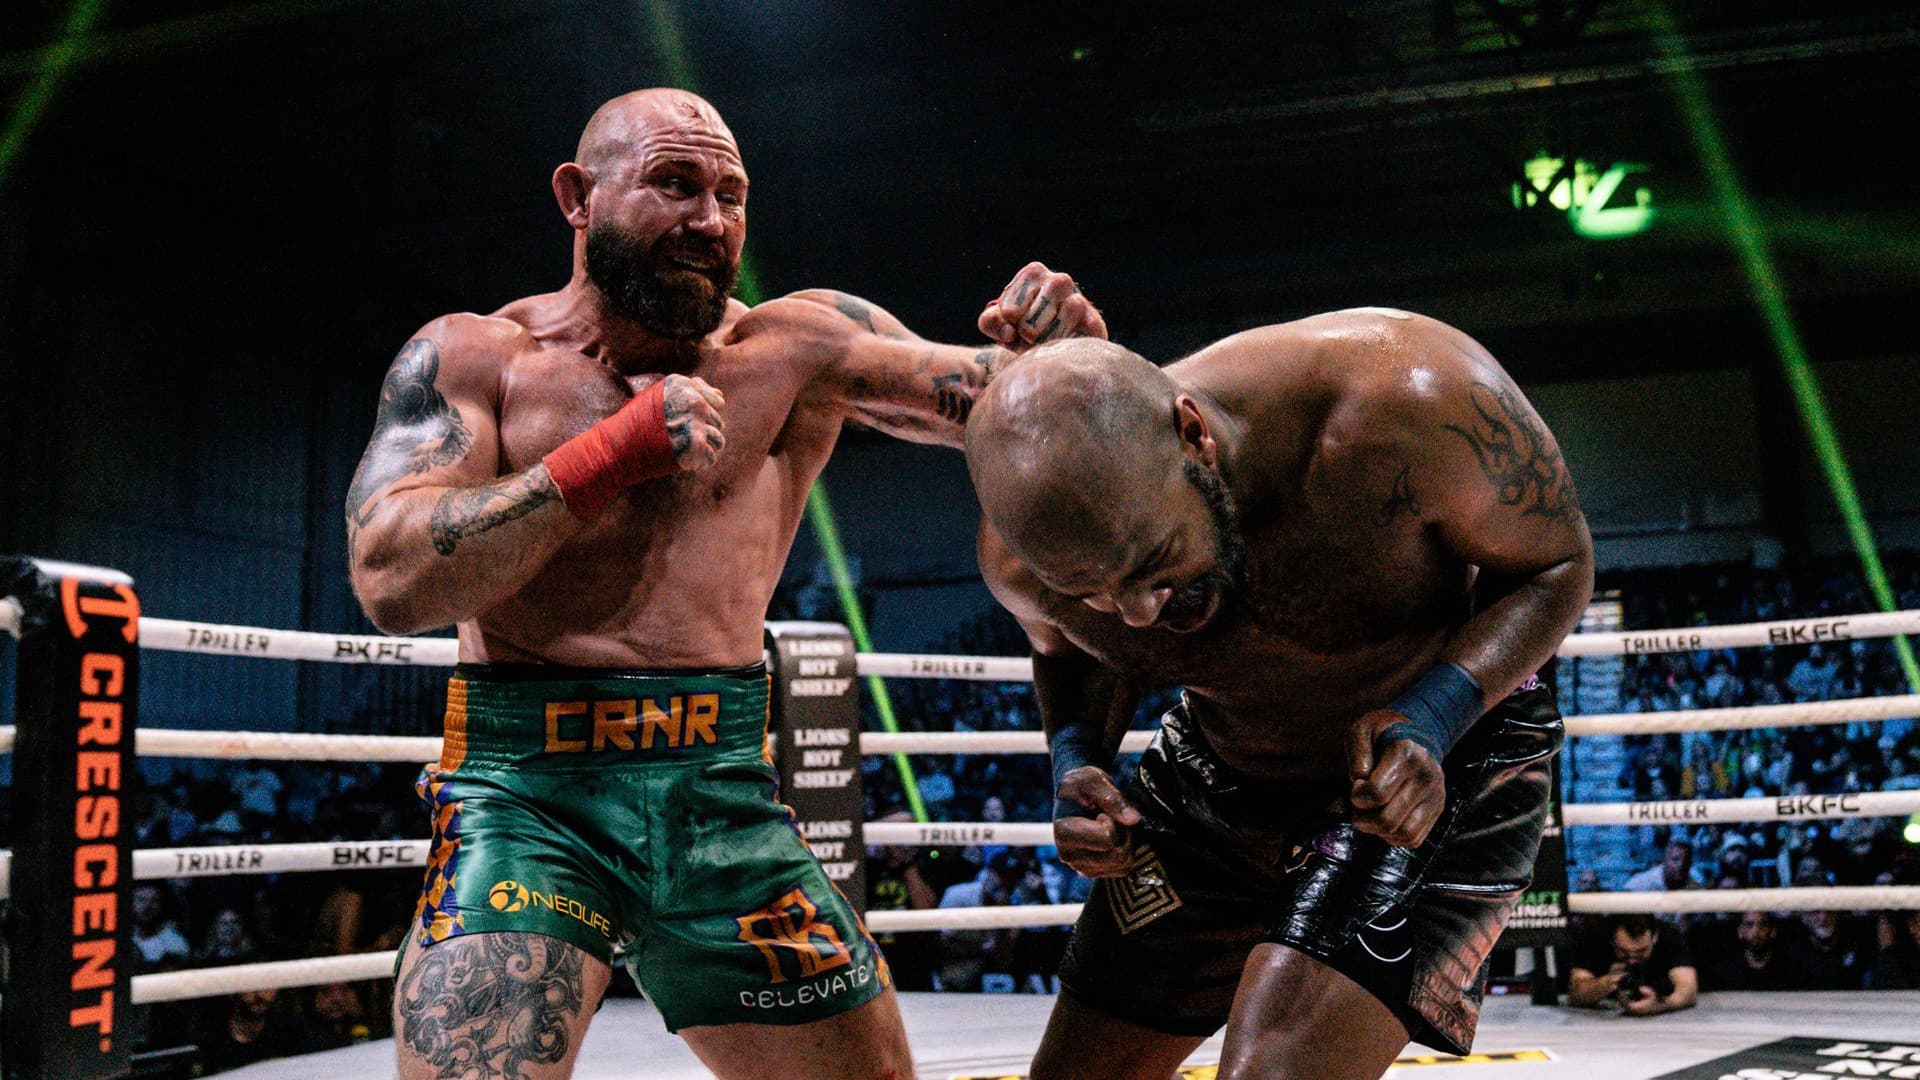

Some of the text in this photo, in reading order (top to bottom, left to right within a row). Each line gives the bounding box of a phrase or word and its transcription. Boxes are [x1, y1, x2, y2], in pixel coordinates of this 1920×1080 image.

[186, 628, 413, 662] TRILLER BKFC
[1622, 621, 1852, 651] TRILLER BKFC
[799, 659, 838, 676] NOT
[912, 659, 986, 675] TRILLER
[543, 693, 720, 754] CRNR
[794, 728, 850, 747] LIONS
[803, 749, 842, 767] NOT
[1627, 794, 1861, 821] TRILLER BKFC
[69, 652, 125, 1030] CRESCENT
[799, 820, 853, 839] LIONS
[920, 828, 995, 842] TRILLER
[175, 845, 416, 872] TRILLER BKFC
[821, 861, 858, 880] EEP
[1519, 891, 1560, 905] AFT
[531, 890, 611, 938] NEOLIFE
[739, 964, 870, 1009] CELEVATE
